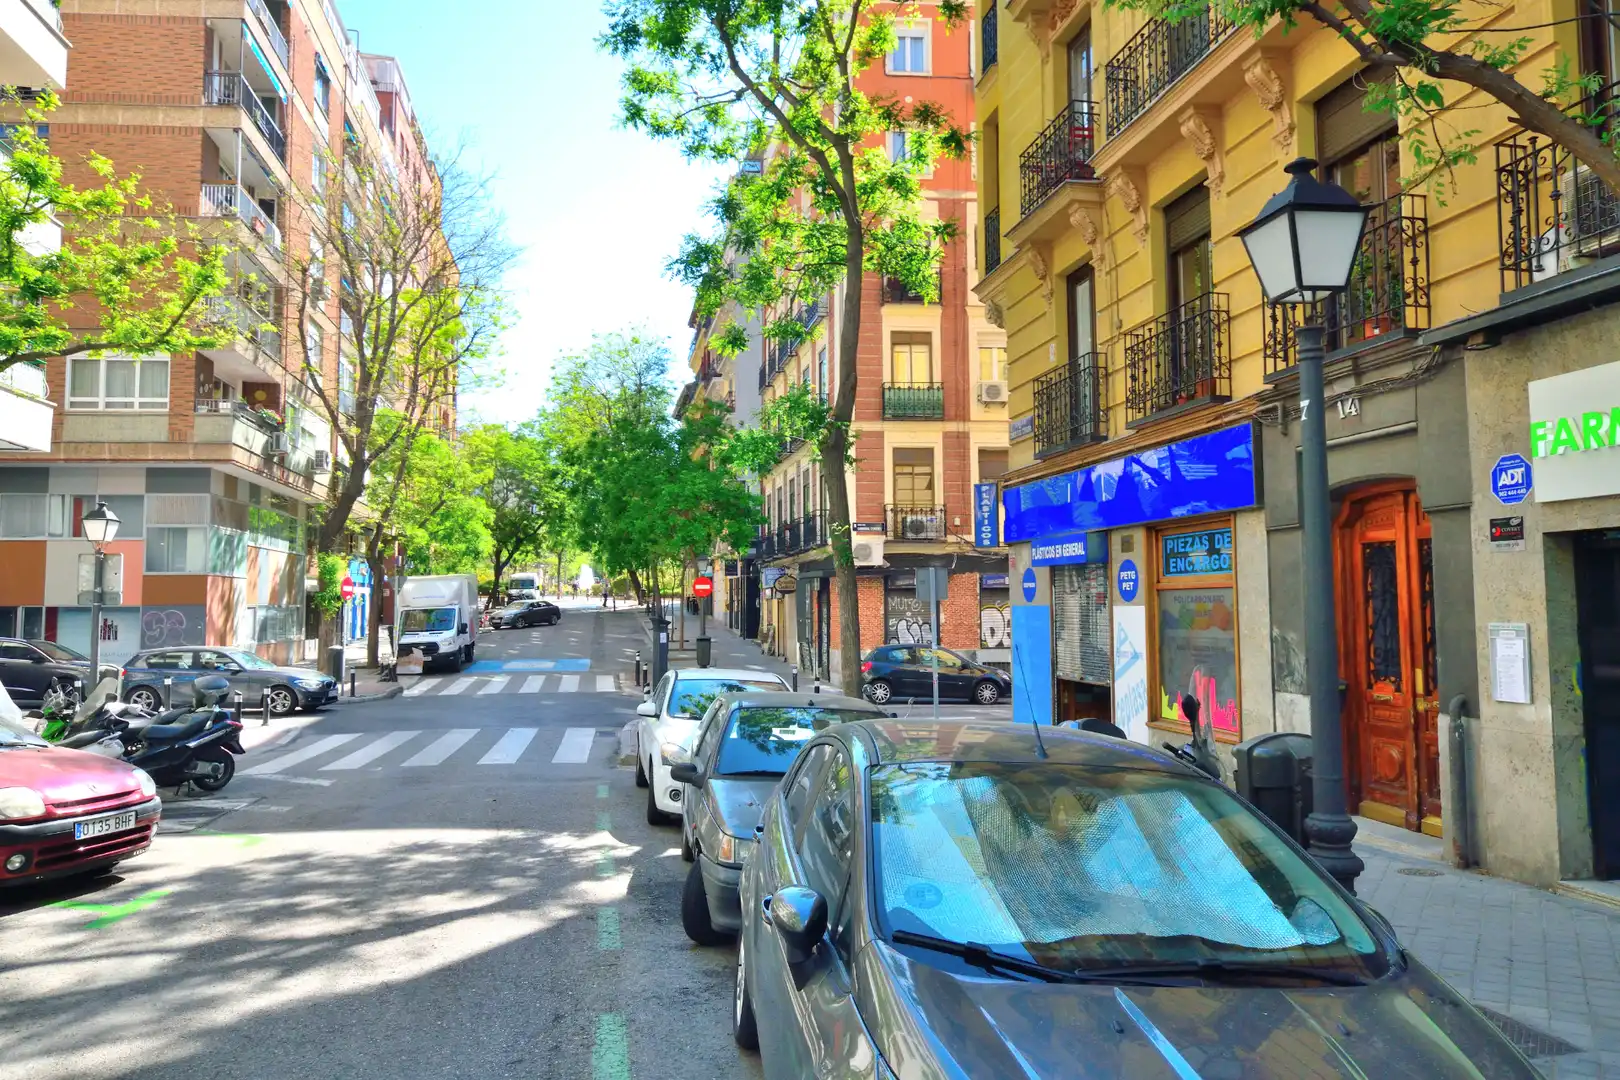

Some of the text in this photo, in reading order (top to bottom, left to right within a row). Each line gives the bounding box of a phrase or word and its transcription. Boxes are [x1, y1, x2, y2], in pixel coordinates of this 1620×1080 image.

[1300, 400, 1310, 421] 7
[1337, 398, 1360, 419] 14
[1498, 467, 1525, 487] ADT
[981, 485, 991, 546] PLASTICOS
[1063, 541, 1085, 557] GENERAL
[1166, 532, 1232, 554] PIEZAS DE
[1169, 554, 1230, 573] ENCARGO
[1120, 570, 1136, 580] PETG
[1122, 581, 1134, 591] PET
[83, 814, 133, 836] 0135 BHF
